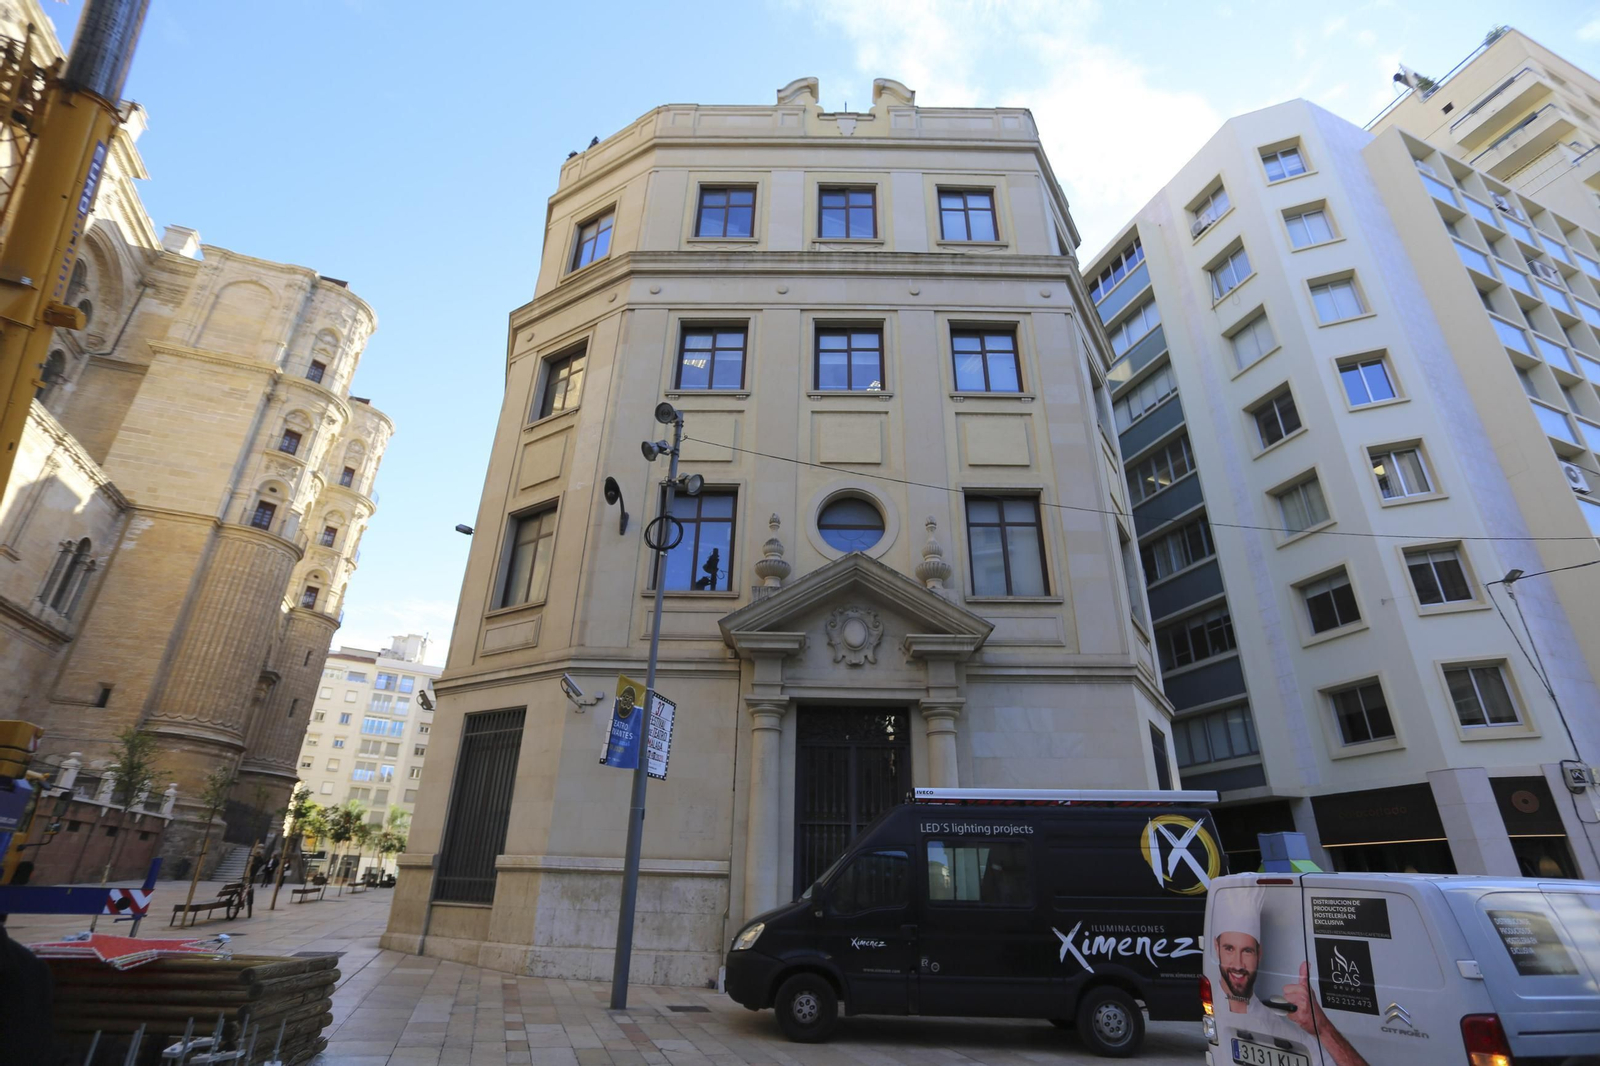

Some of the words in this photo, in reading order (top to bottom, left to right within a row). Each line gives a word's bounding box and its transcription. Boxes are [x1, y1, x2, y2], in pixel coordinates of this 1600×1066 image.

[951, 823, 991, 835] lighting
[993, 824, 1034, 835] projects
[1091, 925, 1165, 933] ILUMINACIONES
[1331, 971, 1361, 987] GAS
[1333, 985, 1361, 993] GRUPO
[1326, 996, 1340, 1004] 952
[1342, 997, 1356, 1006] 212
[1357, 1000, 1372, 1008] 473
[1241, 1044, 1272, 1066] 3131
